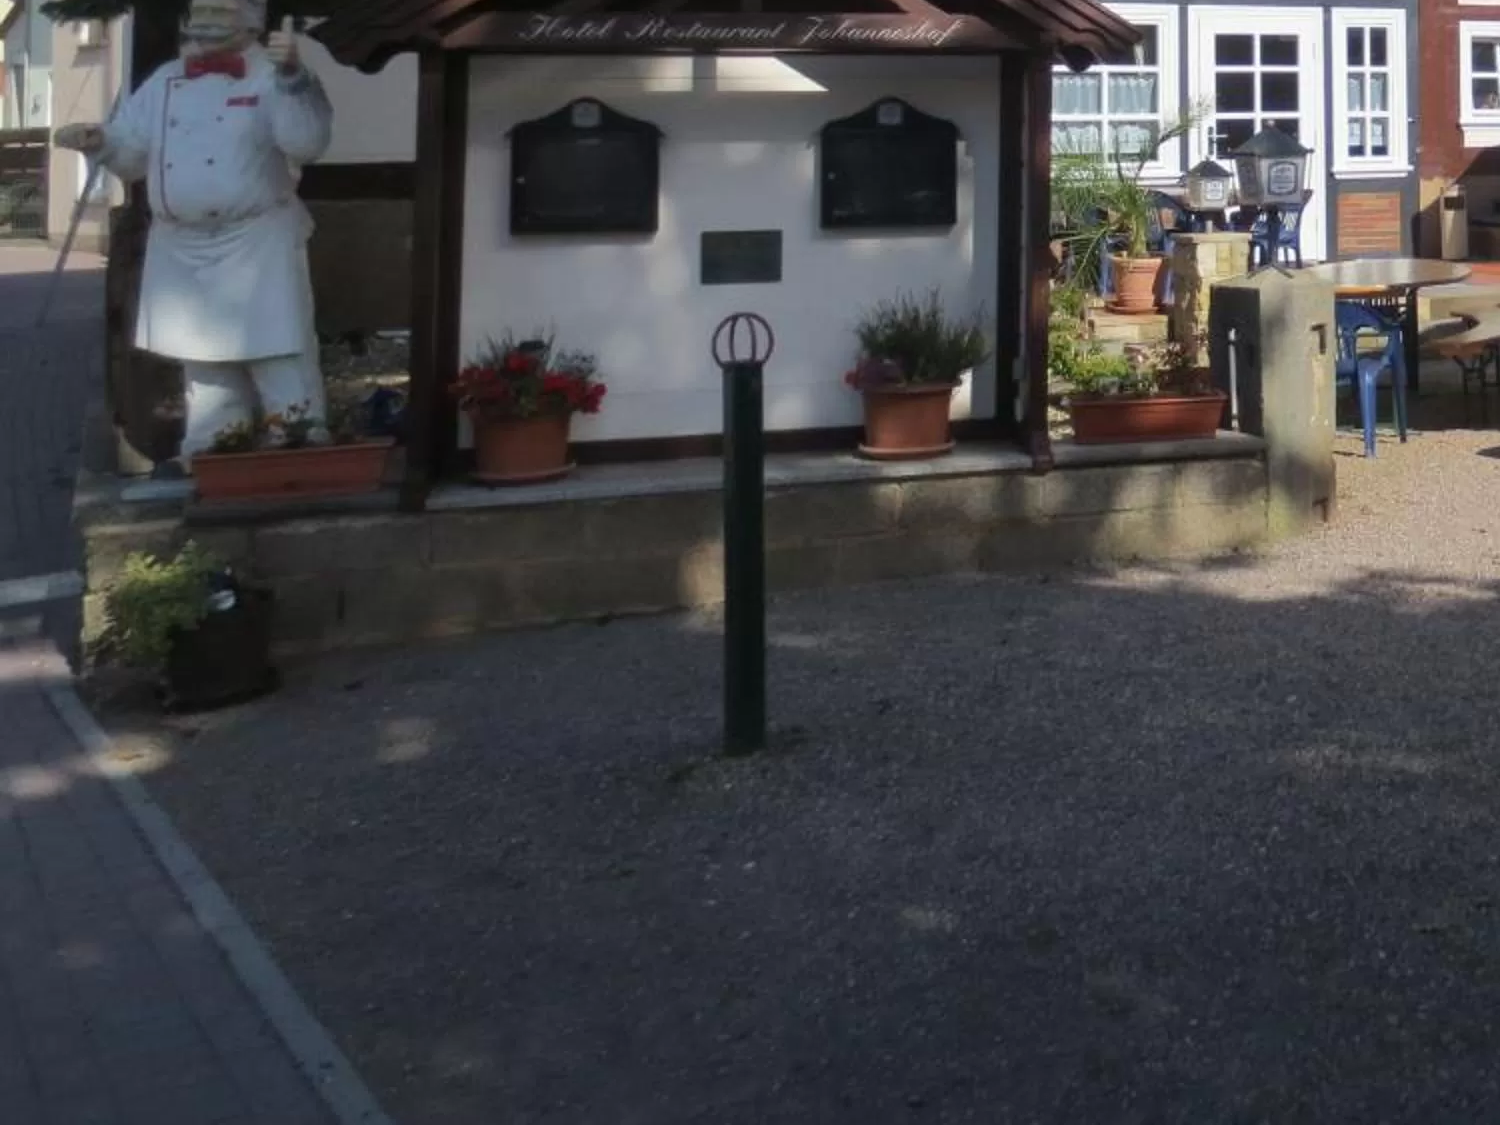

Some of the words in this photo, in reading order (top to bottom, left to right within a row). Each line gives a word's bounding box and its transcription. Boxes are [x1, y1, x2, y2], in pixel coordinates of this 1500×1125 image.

[518, 14, 613, 41] Hotel
[624, 17, 788, 42] Restaurant
[799, 16, 966, 48] Johanneshof
